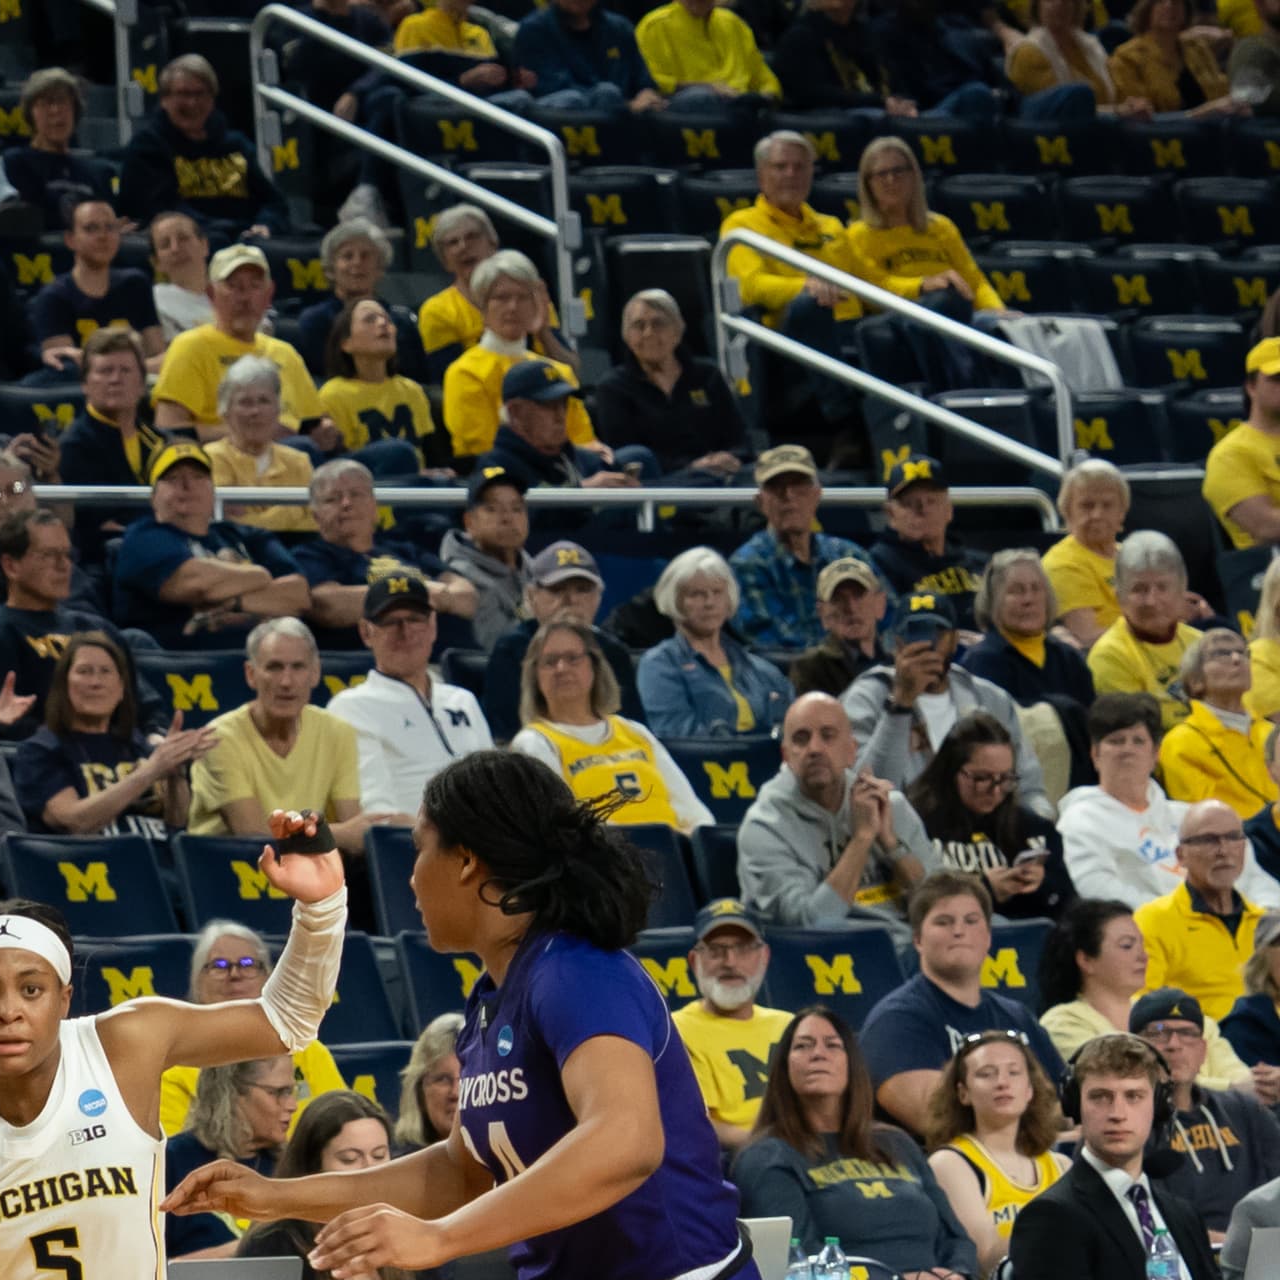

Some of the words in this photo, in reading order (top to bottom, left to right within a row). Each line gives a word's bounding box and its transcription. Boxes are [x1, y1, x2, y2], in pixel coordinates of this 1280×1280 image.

[438, 121, 477, 151] M
[562, 127, 601, 156] M
[681, 128, 720, 158] M
[920, 136, 957, 164] M
[1037, 137, 1072, 164] M
[272, 145, 299, 172] M
[1152, 140, 1185, 166] M
[587, 195, 628, 225] M
[970, 202, 1010, 232] M
[1097, 204, 1132, 232] M
[1219, 206, 1252, 235] M
[15, 255, 54, 283] M
[288, 259, 326, 290] M
[991, 271, 1032, 302] M
[1112, 274, 1151, 304] M
[1232, 277, 1268, 306] M
[1166, 349, 1207, 380] M
[357, 403, 420, 444] M
[1075, 418, 1112, 449] M
[902, 461, 929, 480] M
[388, 576, 410, 592] M
[166, 674, 219, 710] M
[445, 708, 471, 727] M
[704, 762, 756, 798] M
[58, 862, 117, 902] M
[641, 957, 697, 997] M
[805, 954, 862, 995] M
[978, 948, 1025, 988] M
[101, 966, 156, 1006] M
[471, 1067, 529, 1108] CROSS
